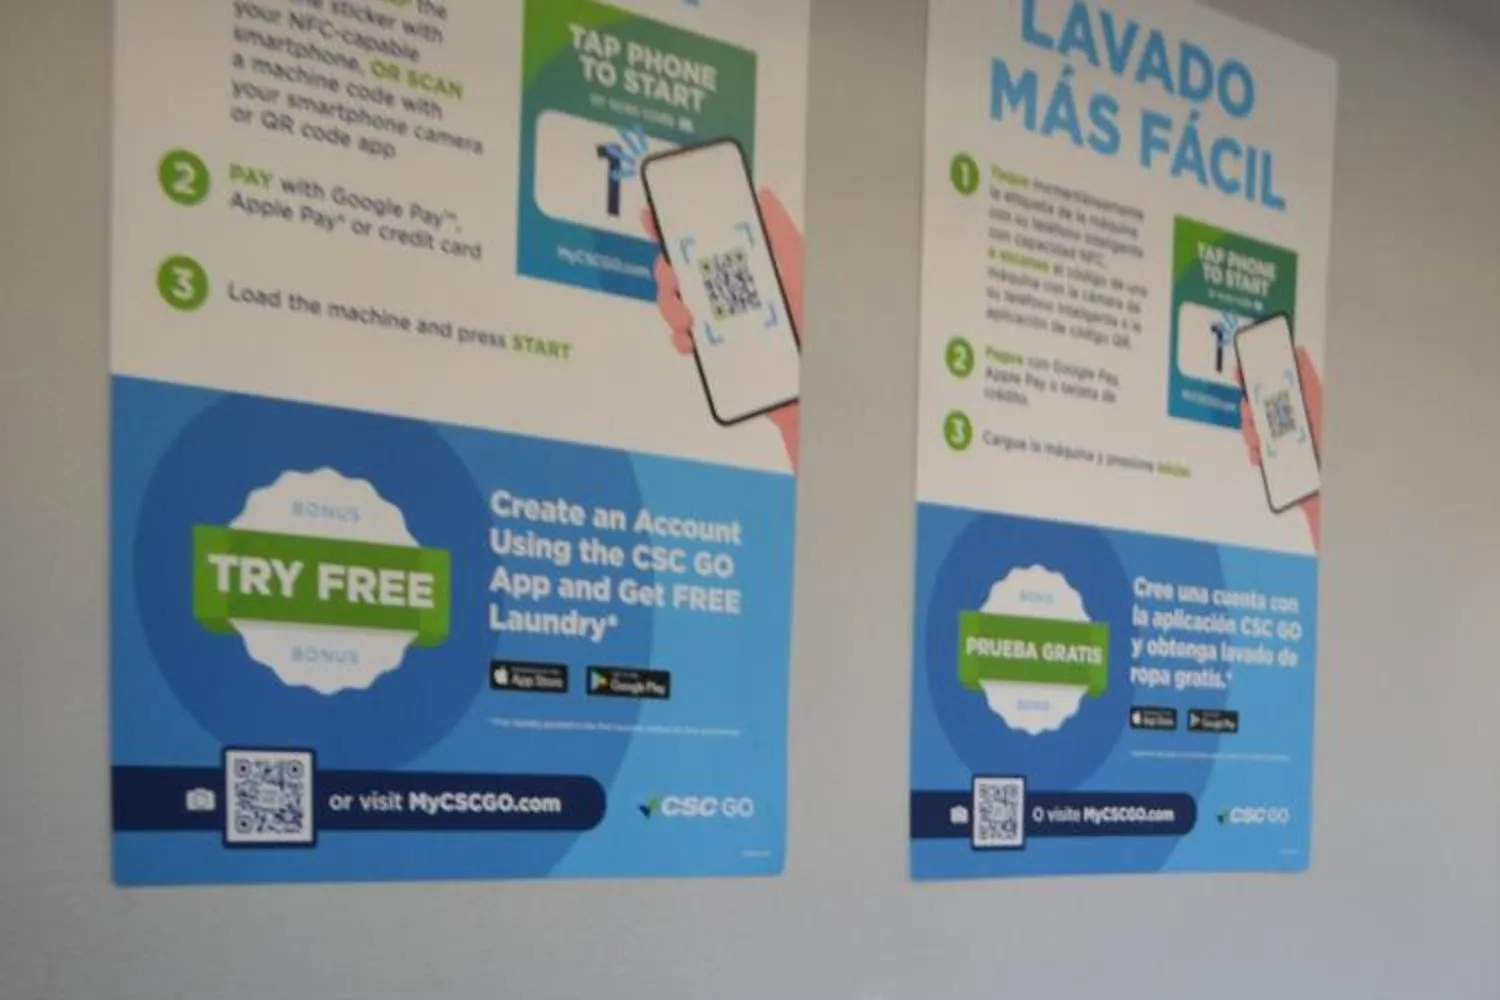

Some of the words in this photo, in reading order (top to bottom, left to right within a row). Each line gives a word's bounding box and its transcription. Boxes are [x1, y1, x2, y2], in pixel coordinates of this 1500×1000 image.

[233, 3, 281, 25] your
[402, 22, 443, 44] with
[568, 23, 621, 59] TAP
[626, 41, 719, 93] PHONE
[1021, 0, 1256, 119] LAVADO
[231, 53, 246, 70] a
[252, 56, 340, 93] machine
[346, 79, 395, 106] code
[400, 95, 443, 120] with
[369, 58, 401, 81] OR
[407, 68, 464, 100] SCAN
[579, 54, 617, 88] TO
[623, 69, 706, 113] START
[230, 107, 253, 124] or
[260, 111, 295, 136] QR
[301, 120, 351, 149] code
[358, 136, 397, 160] app
[231, 80, 281, 104] your
[287, 92, 408, 136] smartphone
[414, 126, 484, 156] camera
[989, 56, 1121, 156] MÁS
[1139, 108, 1286, 212] FÁCIL
[171, 161, 197, 196] 2
[229, 163, 274, 190] PAY
[280, 175, 326, 201] with
[331, 186, 404, 220] Google
[230, 192, 295, 222] Apple
[351, 218, 373, 237] or
[378, 222, 435, 252] credit
[440, 236, 483, 261] card
[1197, 241, 1225, 268] TAP
[1227, 249, 1277, 282] PHONE
[1203, 260, 1223, 284] TO
[1226, 268, 1270, 297] START
[171, 266, 196, 300] 3
[228, 282, 282, 309] Load
[288, 292, 322, 316] the
[327, 301, 411, 332] machine
[416, 318, 453, 340] and
[457, 322, 508, 350] press
[511, 332, 572, 360] START
[954, 345, 968, 372] 2
[952, 417, 966, 447] 3
[290, 499, 361, 525] BONUS
[489, 489, 584, 527] Create
[592, 504, 627, 532] an
[633, 508, 743, 546] Account
[489, 528, 573, 566] Using
[579, 539, 624, 567] the
[631, 545, 687, 576] CSC
[693, 552, 734, 578] GO
[207, 553, 305, 599] TRY
[317, 563, 435, 609] FREE
[489, 565, 550, 600] App
[557, 576, 611, 602] and
[618, 578, 666, 608] Get
[672, 584, 743, 615] FREE
[1133, 575, 1174, 600] Cree
[1177, 585, 1209, 604] una
[1212, 586, 1267, 610] cuenta
[1270, 596, 1299, 612] con
[1132, 603, 1149, 625] la
[1152, 608, 1238, 635] aplicación
[1240, 617, 1273, 638] CSC
[1276, 620, 1303, 640] GO
[290, 644, 359, 666] BONUS
[966, 636, 1038, 661] PRUEBA
[1042, 641, 1103, 666] GRATIS
[1131, 639, 1143, 658] y
[1146, 636, 1219, 664] obtenga
[1221, 642, 1275, 667] lavado
[1277, 648, 1297, 668] de
[1130, 666, 1171, 687] ropa
[328, 792, 353, 811] or
[358, 790, 403, 812] visit
[408, 790, 562, 817] MyCSCGO.com
[660, 796, 717, 817] CSC
[720, 797, 755, 818] GO
[1032, 806, 1045, 823] O
[1047, 805, 1081, 824] visite
[1082, 805, 1175, 827] MyCSCGO.com
[1229, 807, 1266, 824] CSC
